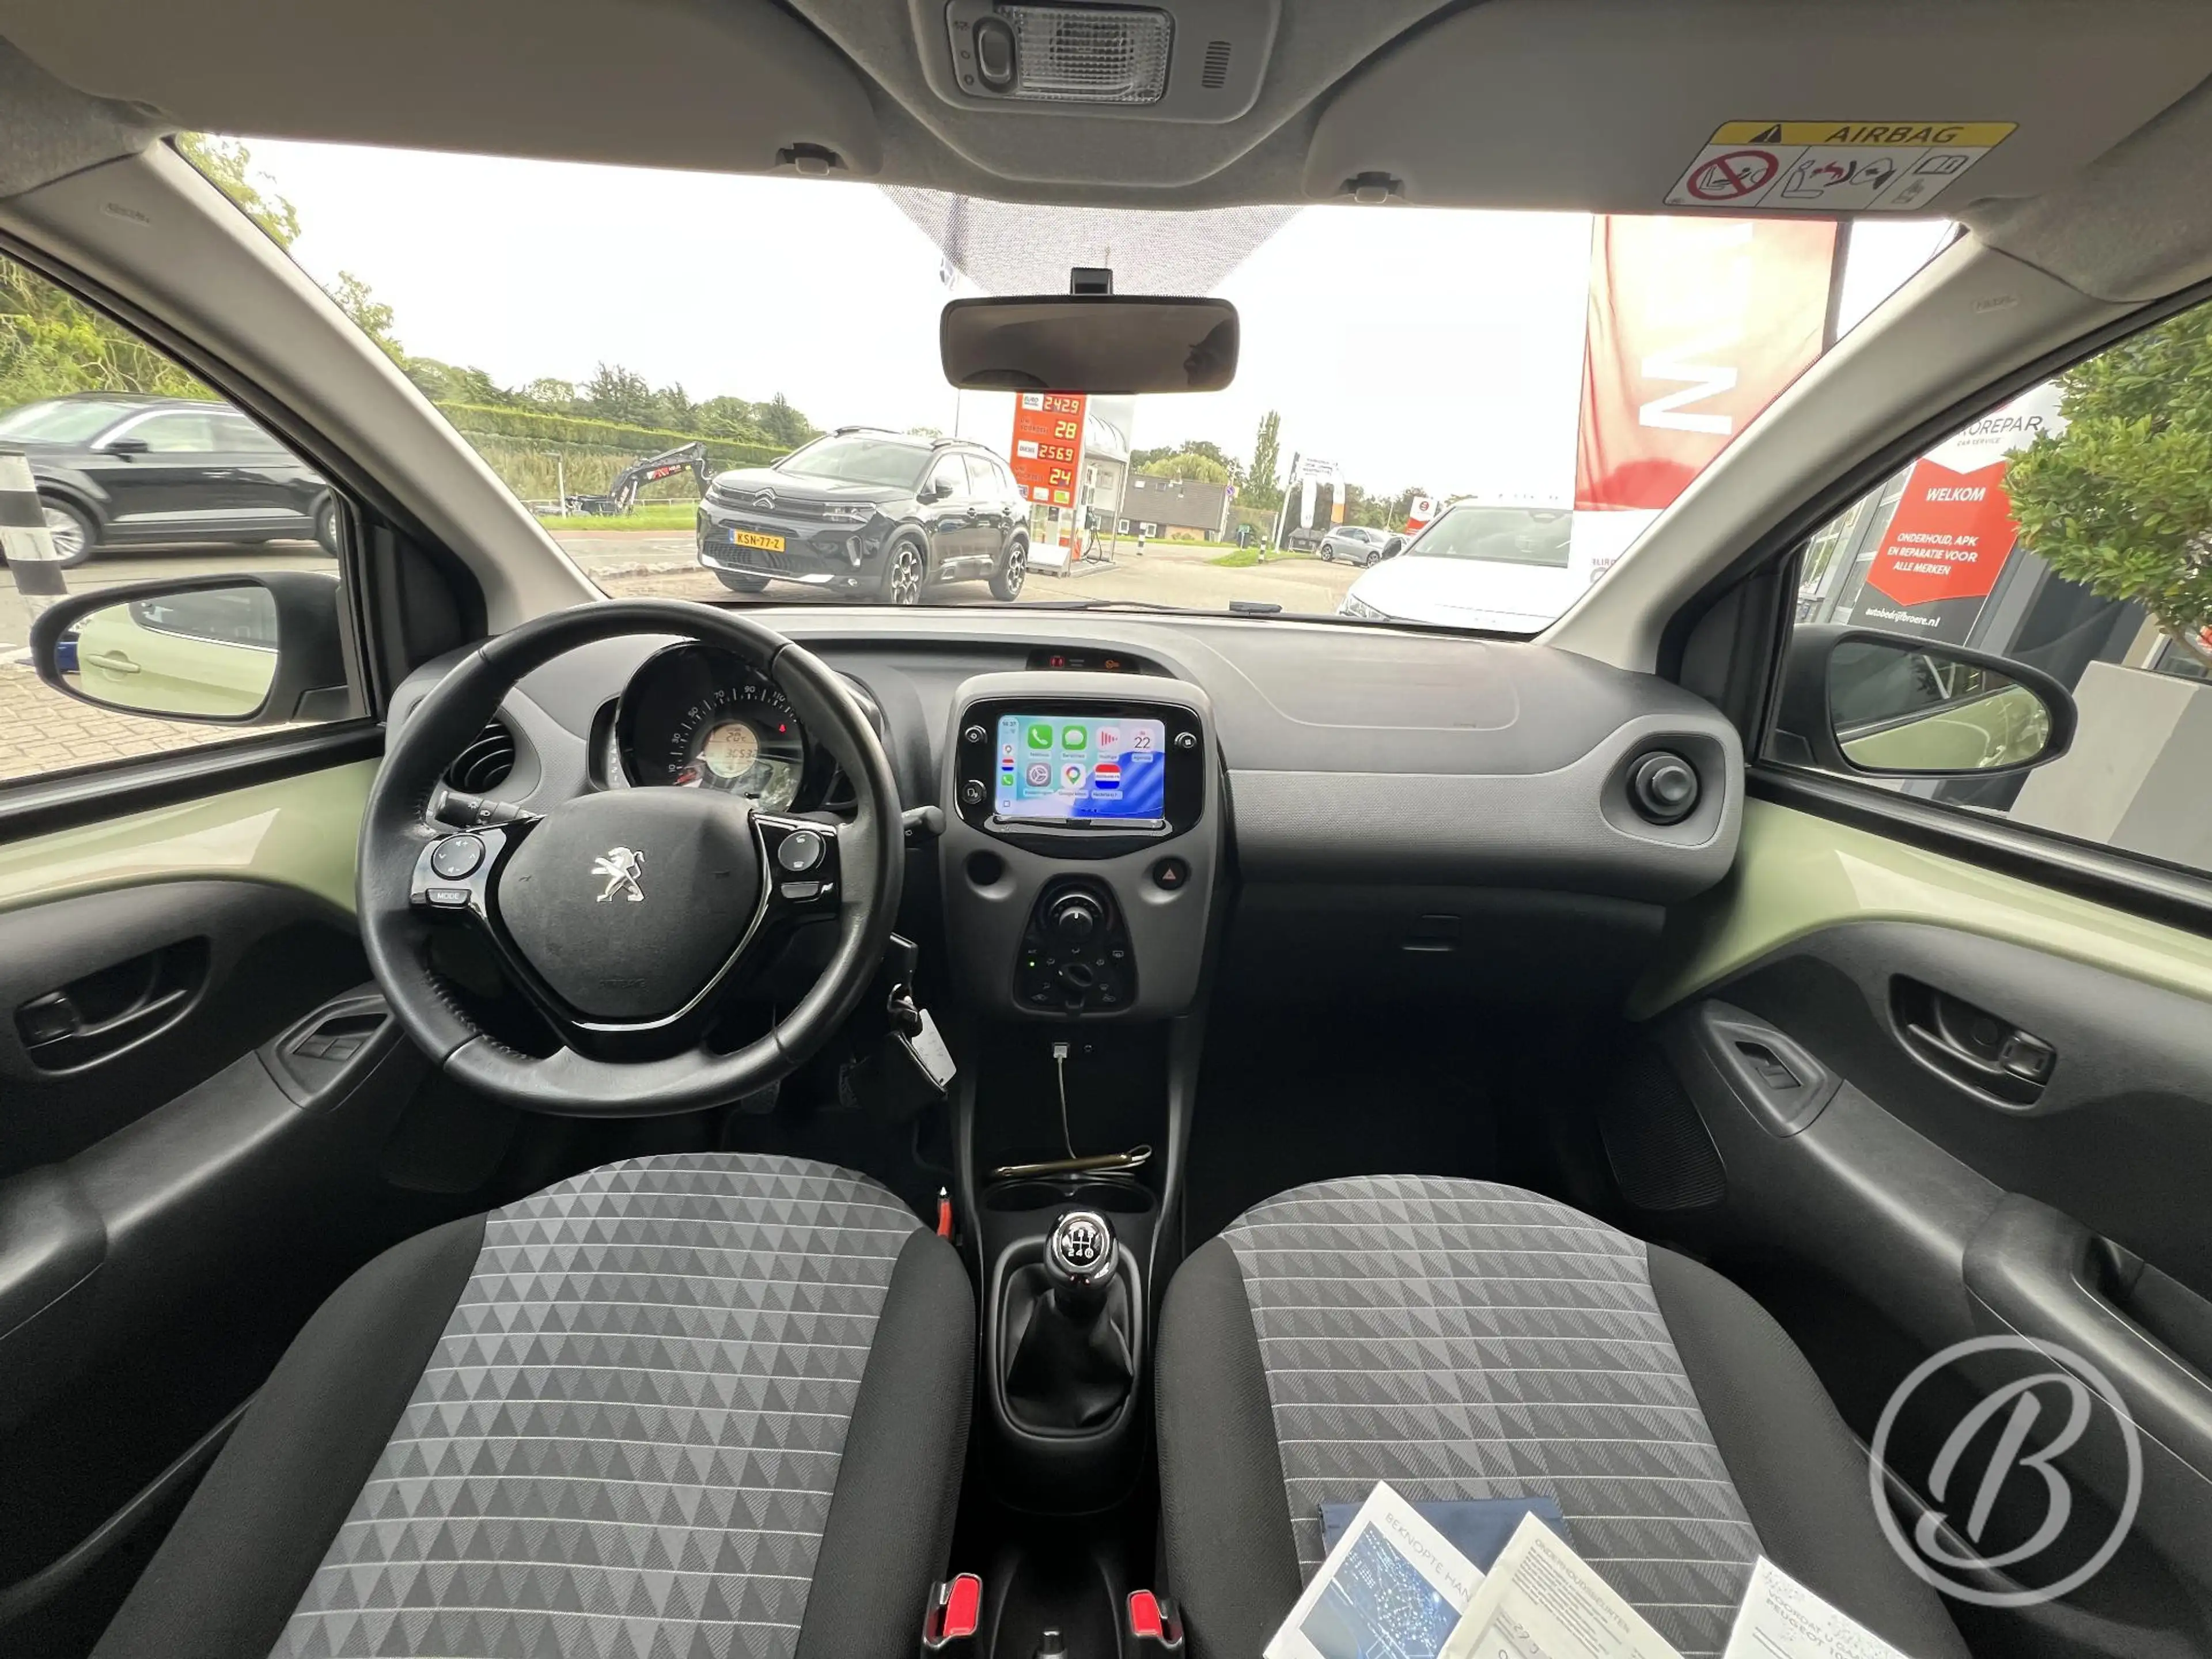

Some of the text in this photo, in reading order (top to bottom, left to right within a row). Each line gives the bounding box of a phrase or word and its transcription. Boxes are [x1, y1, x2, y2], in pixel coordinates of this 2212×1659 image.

[1824, 126, 1964, 143] AIRBAG
[1044, 396, 1080, 414] 2429
[1054, 421, 1078, 439] 28
[1039, 445, 1074, 461] 2569
[1049, 468, 1071, 485] 24
[1926, 487, 1986, 502] WELKOM
[737, 533, 780, 549] KSN-77-Z
[1897, 533, 1979, 546] ONDERHOUD, APK
[1887, 547, 1979, 563] EN REPARATIE VOOR
[1893, 562, 1952, 575] ALLE MERKEN
[1865, 608, 1941, 627] autobedrijfbroere.nl
[1134, 737, 1150, 749] 22
[1384, 1512, 1444, 1574] BEKNOPTE
